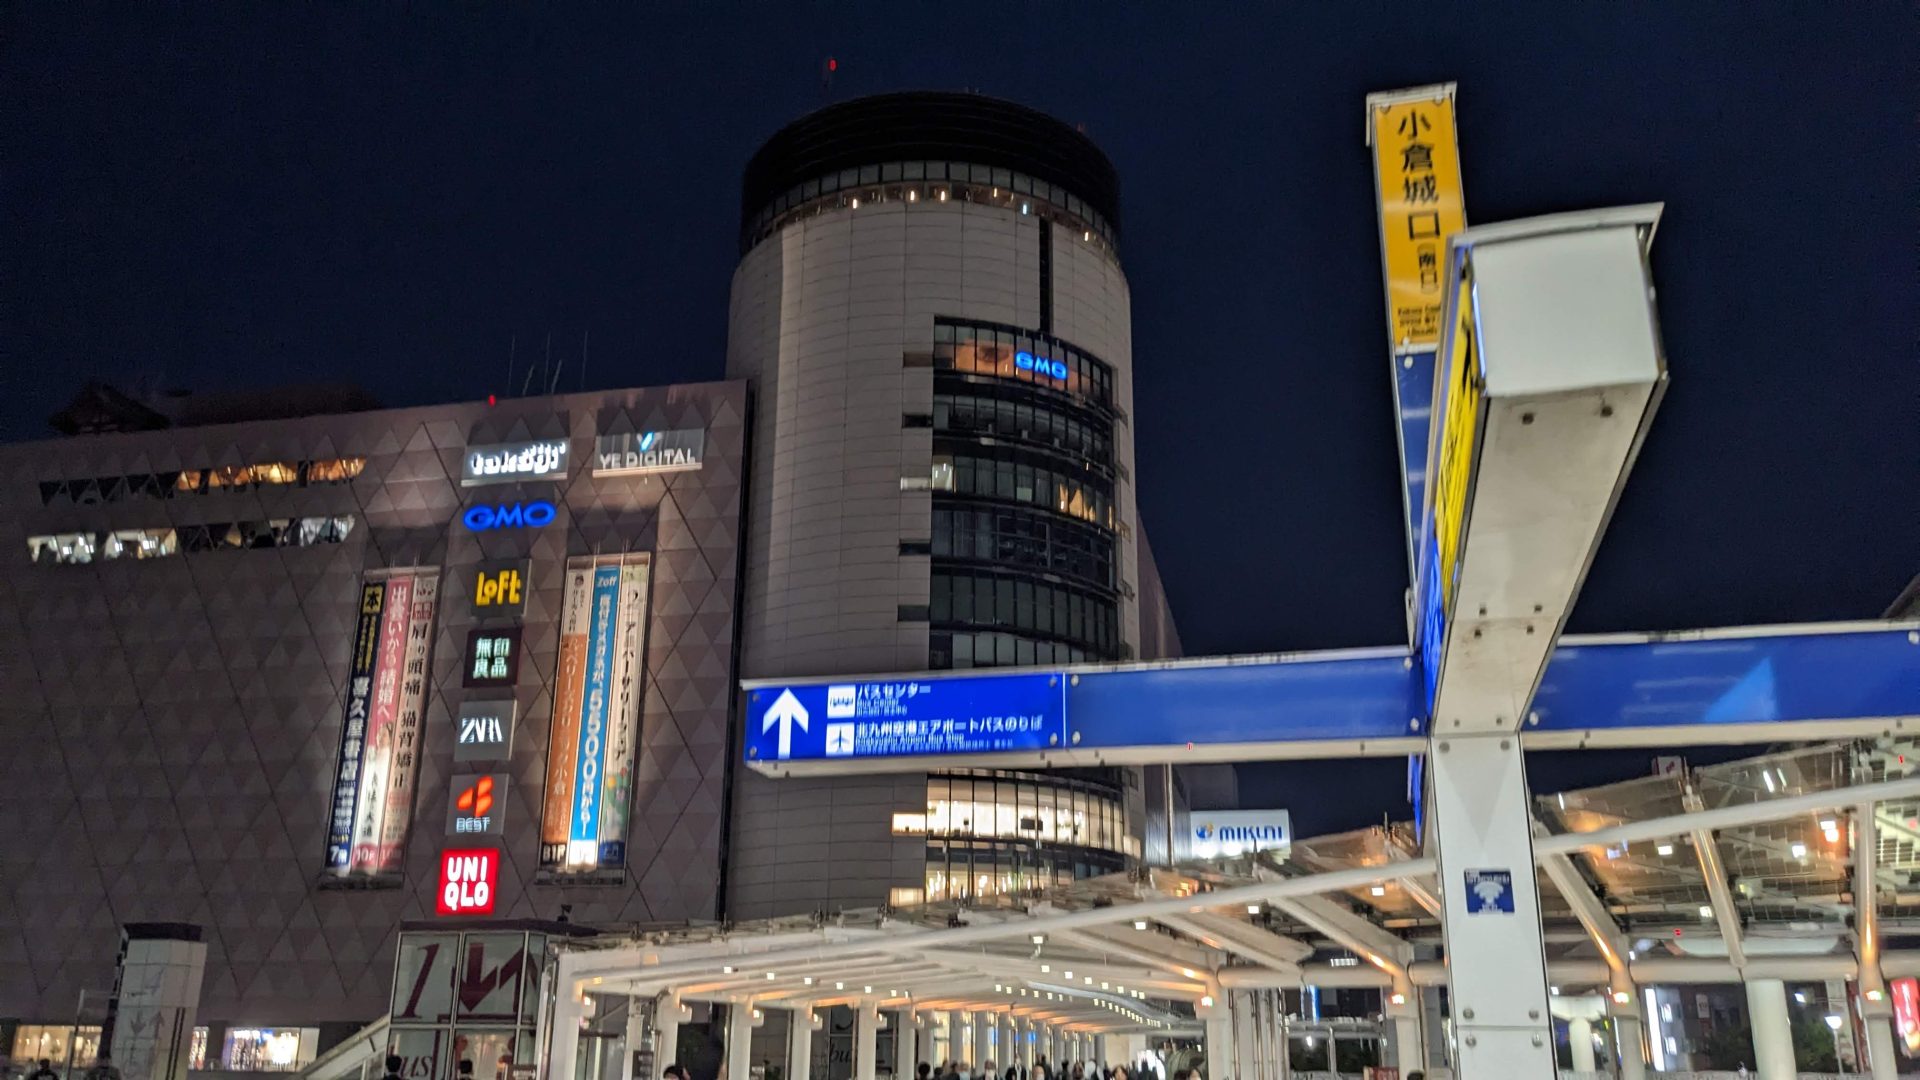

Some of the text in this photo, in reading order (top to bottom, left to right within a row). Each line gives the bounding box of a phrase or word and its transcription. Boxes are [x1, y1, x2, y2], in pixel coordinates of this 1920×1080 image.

[1397, 110, 1440, 240] 小倉城口
[1016, 352, 1066, 379] GMO
[599, 447, 696, 470] YE DIGITAL
[463, 500, 557, 532] GMO
[597, 577, 617, 588] Zoff
[477, 637, 509, 658] 無印
[473, 657, 506, 679] 良品
[857, 682, 931, 699] バスセンター
[456, 816, 491, 833] BEST
[542, 844, 566, 861] B1F
[447, 855, 488, 882] UNI
[444, 880, 490, 912] QLO
